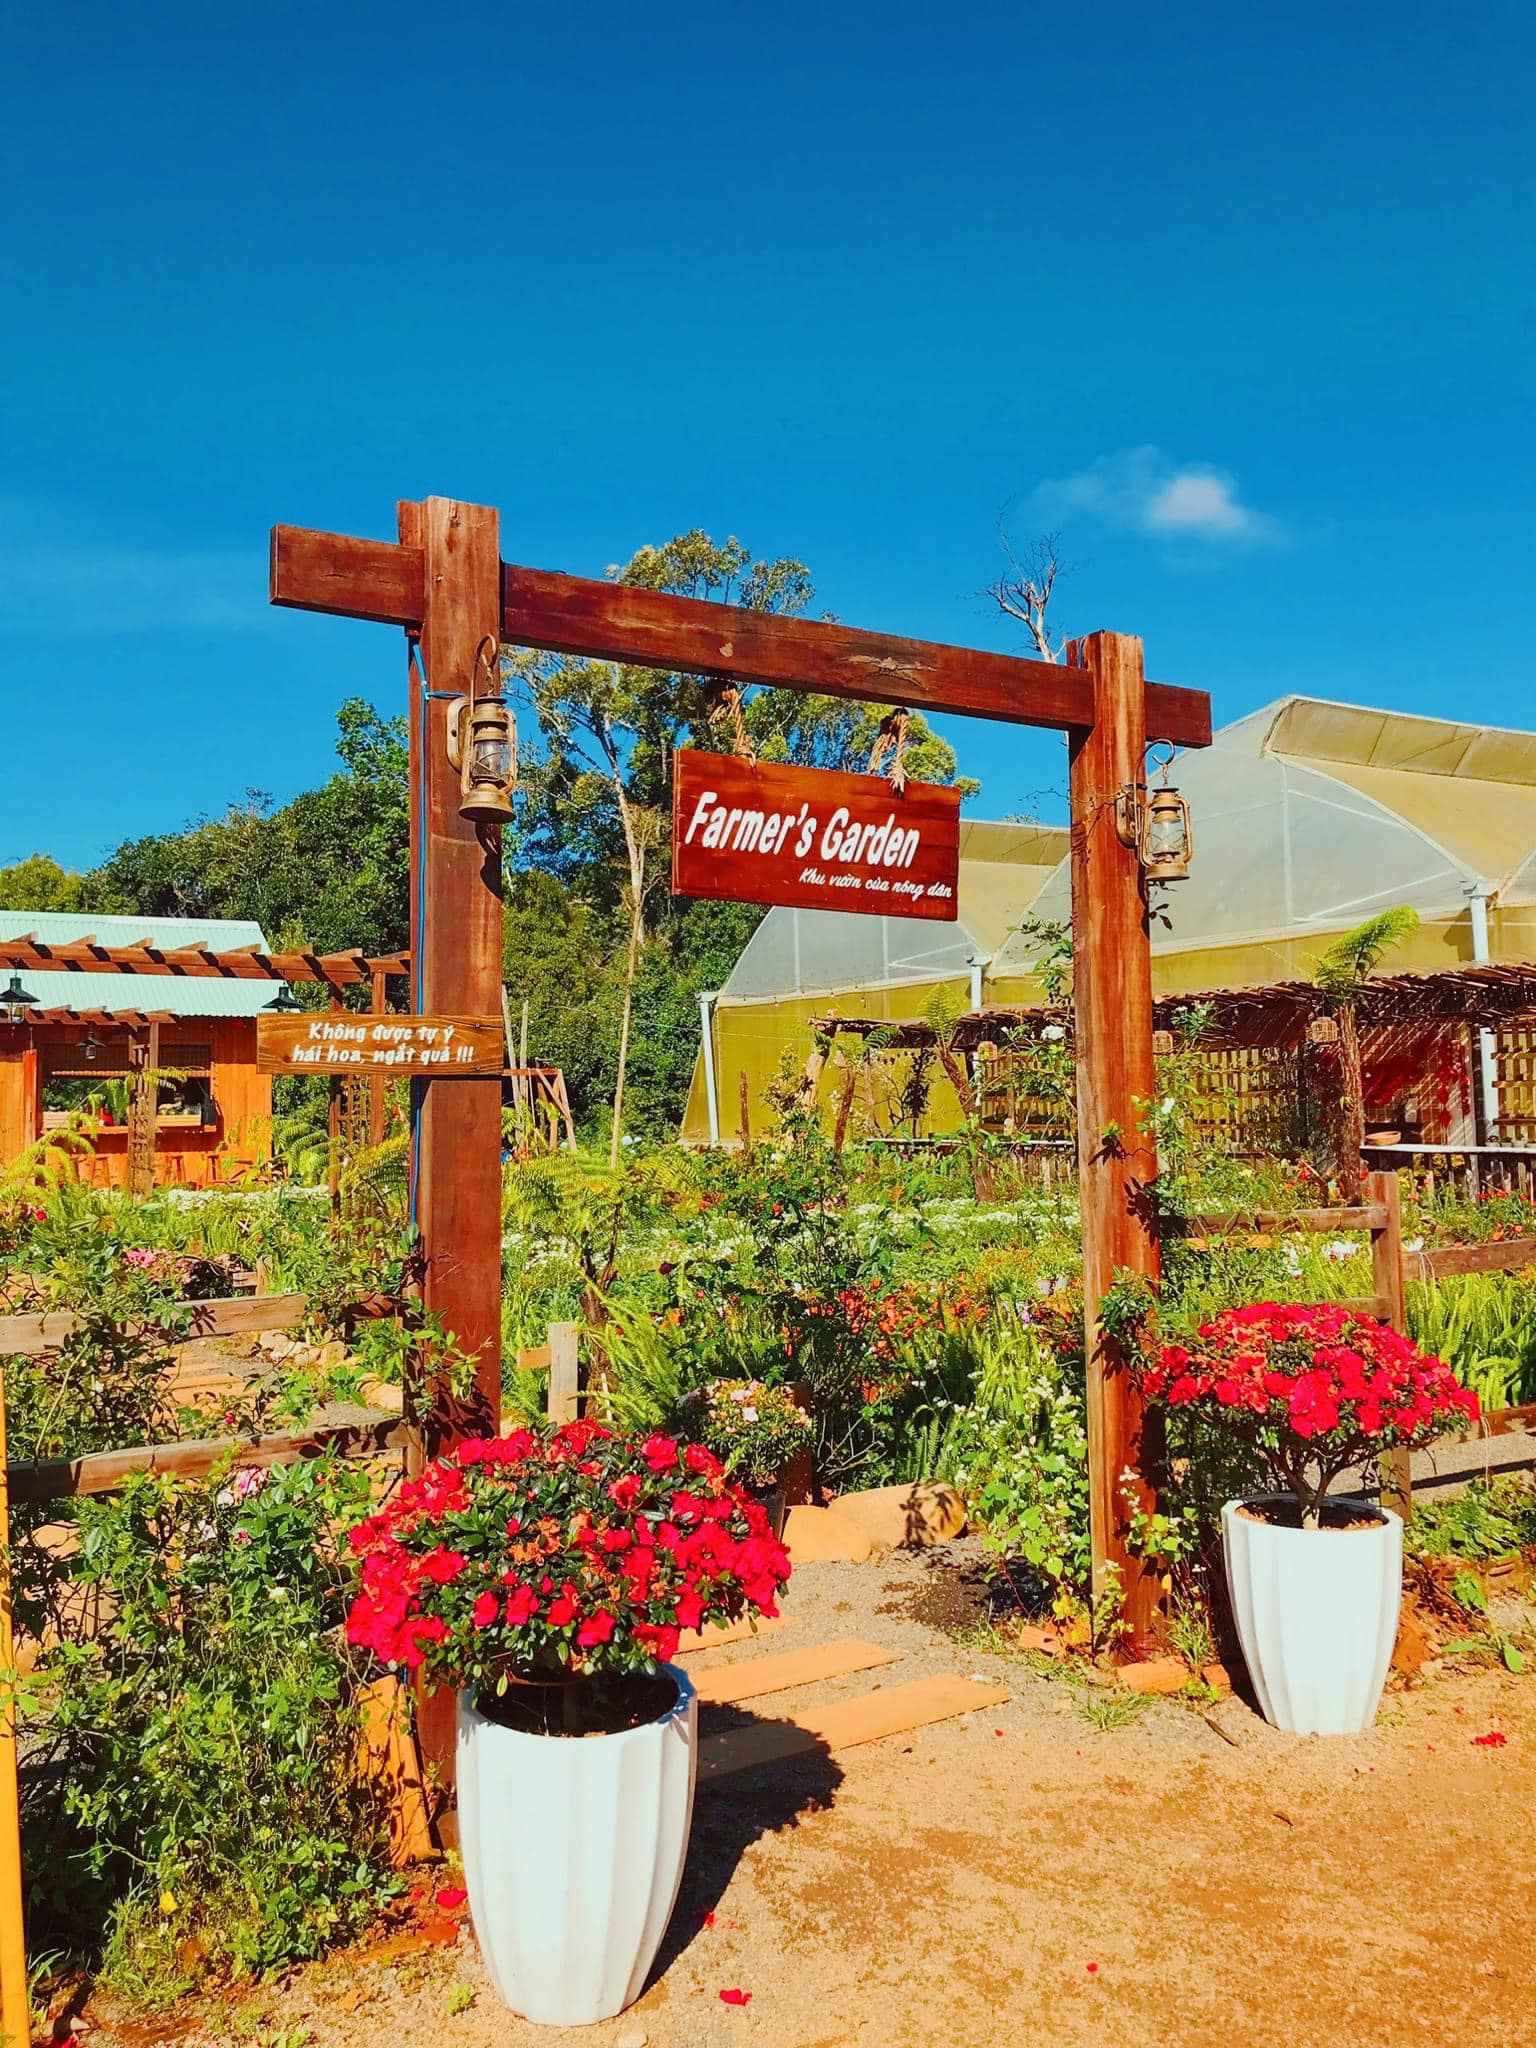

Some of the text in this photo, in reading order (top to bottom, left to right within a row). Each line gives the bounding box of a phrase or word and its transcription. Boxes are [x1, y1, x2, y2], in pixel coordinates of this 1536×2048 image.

[684, 791, 920, 868] Farmer's Garden
[799, 867, 826, 886] Khu
[829, 872, 862, 889] vườn
[892, 880, 924, 902] nông
[927, 881, 953, 898] dân
[308, 1022, 455, 1045] Không được tự ý
[292, 1044, 322, 1062] hái
[327, 1044, 366, 1064] hoa,
[456, 1046, 474, 1063] !!!
